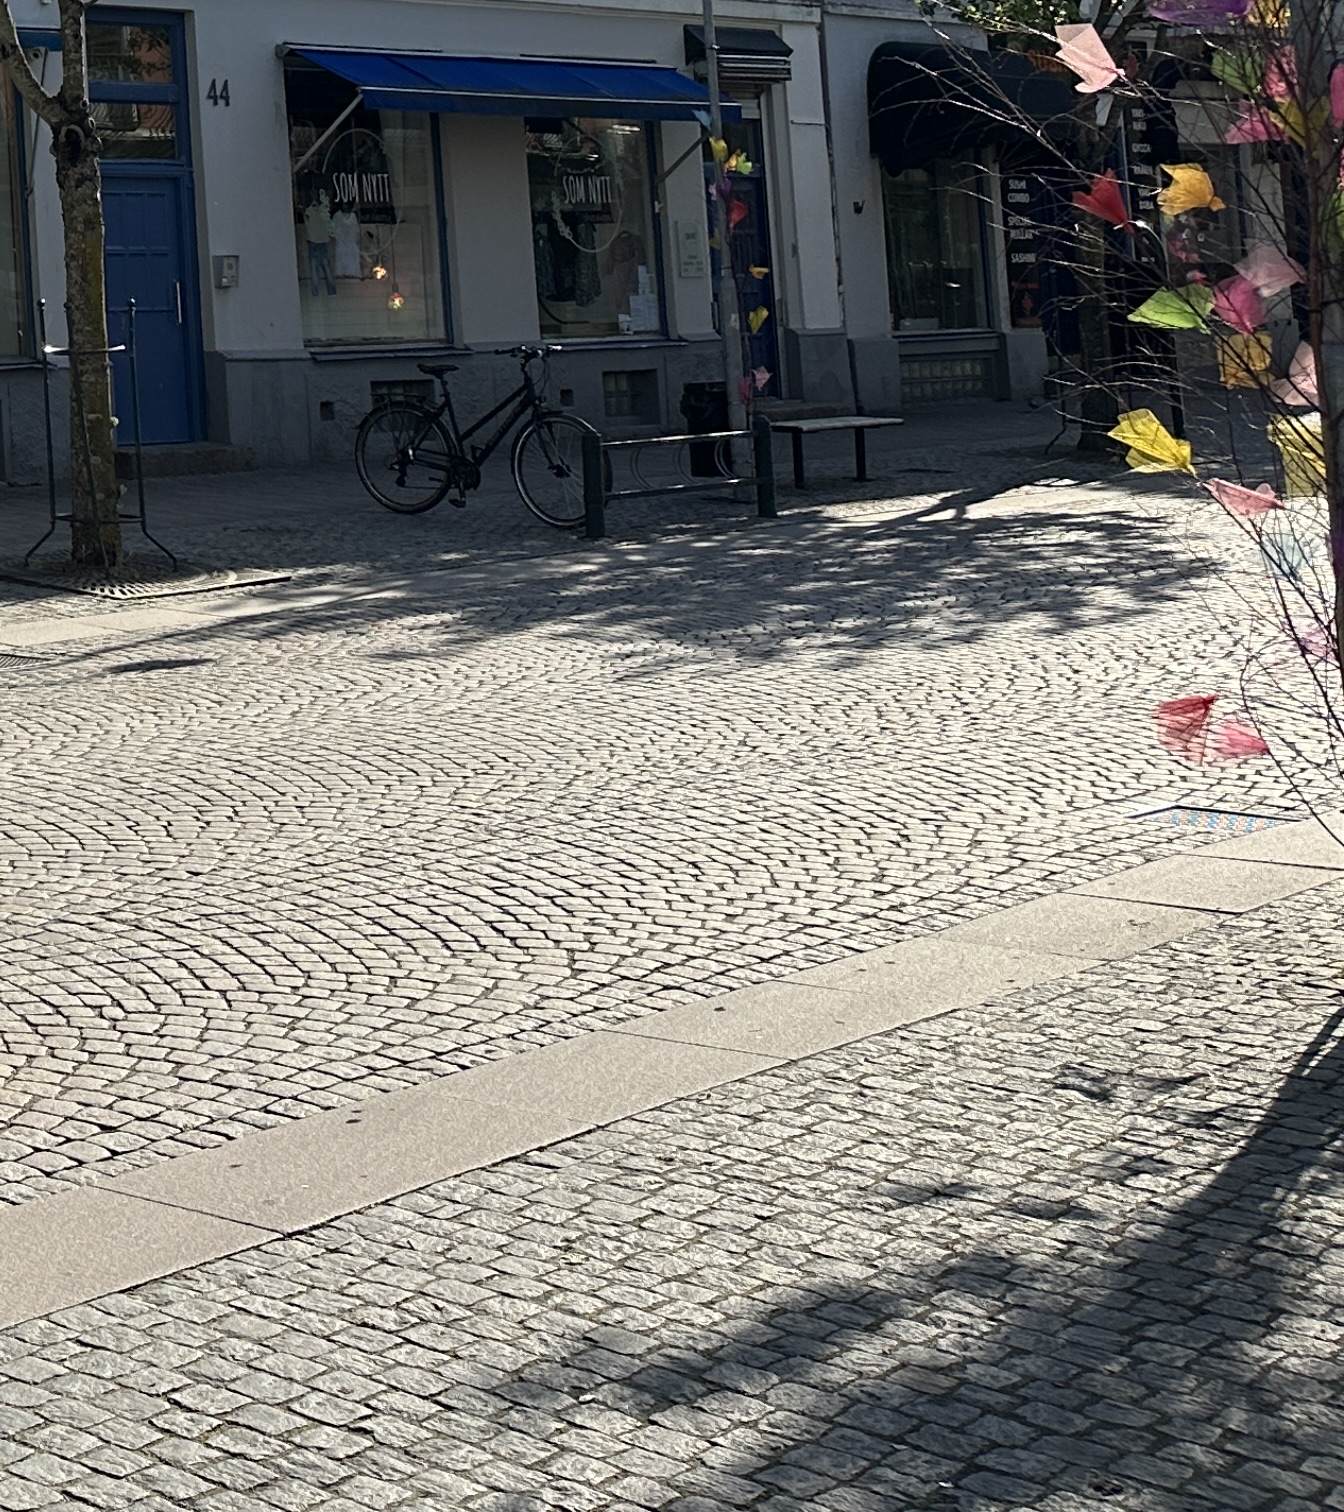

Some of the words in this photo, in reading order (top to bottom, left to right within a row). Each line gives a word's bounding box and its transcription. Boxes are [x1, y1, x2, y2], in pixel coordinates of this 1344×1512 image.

[206, 78, 230, 106] 44
[332, 171, 359, 203] SOM
[362, 172, 390, 203] NYTT
[562, 175, 585, 204] SOM
[588, 175, 612, 204] NYTT
